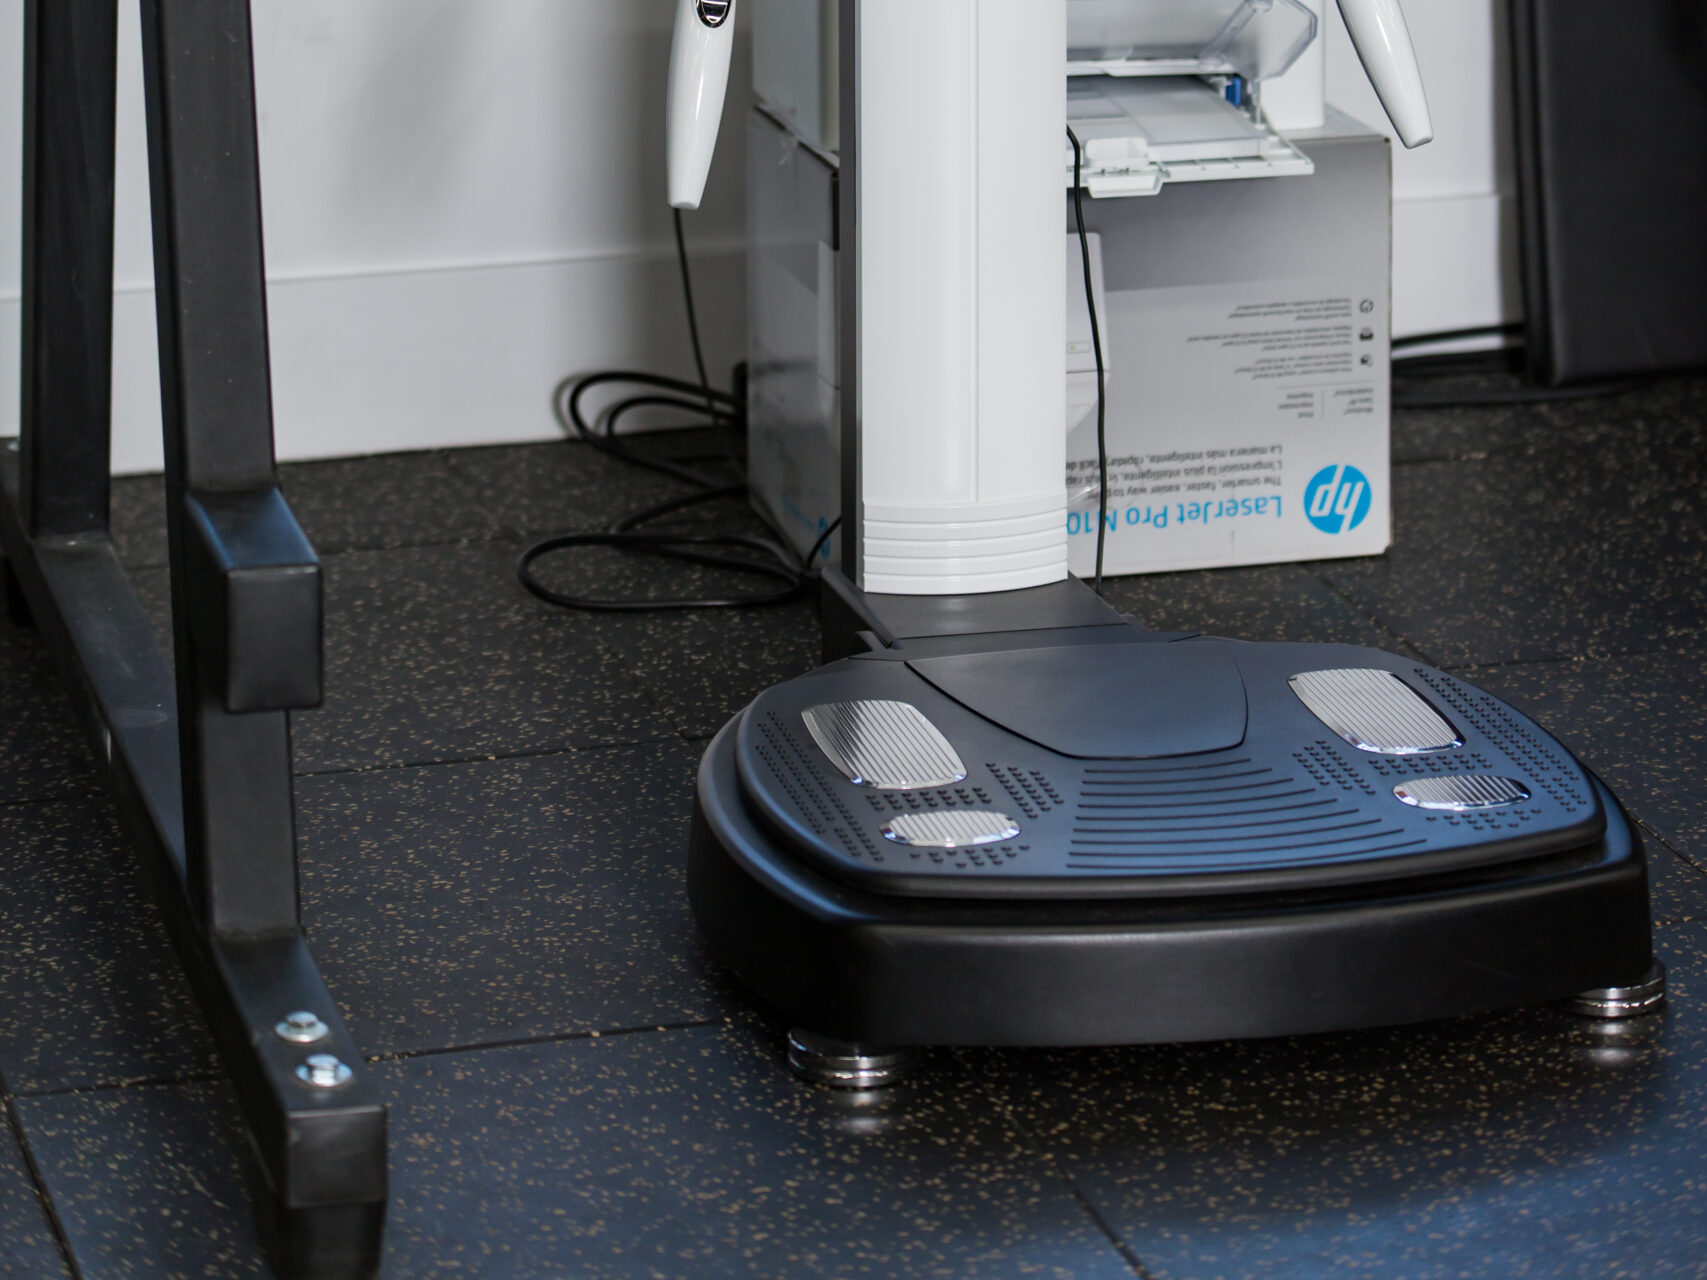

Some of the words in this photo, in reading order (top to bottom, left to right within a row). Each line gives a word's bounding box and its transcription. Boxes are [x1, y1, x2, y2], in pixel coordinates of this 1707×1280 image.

[1206, 450, 1228, 460] más
[1229, 447, 1268, 457] manera
[1270, 444, 1282, 456] La
[1146, 452, 1203, 465] inteligente,
[1122, 468, 1181, 481] intelligente,
[1183, 465, 1205, 477] plus
[1183, 481, 1216, 492] faster,
[1218, 477, 1261, 489] smarter,
[1264, 476, 1282, 486] The
[1113, 489, 1124, 498] to
[1127, 486, 1147, 496] way
[1150, 484, 1180, 495] easier
[1306, 464, 1368, 534] hp
[1176, 495, 1283, 525] LaserJet
[1126, 505, 1168, 529] Pro
